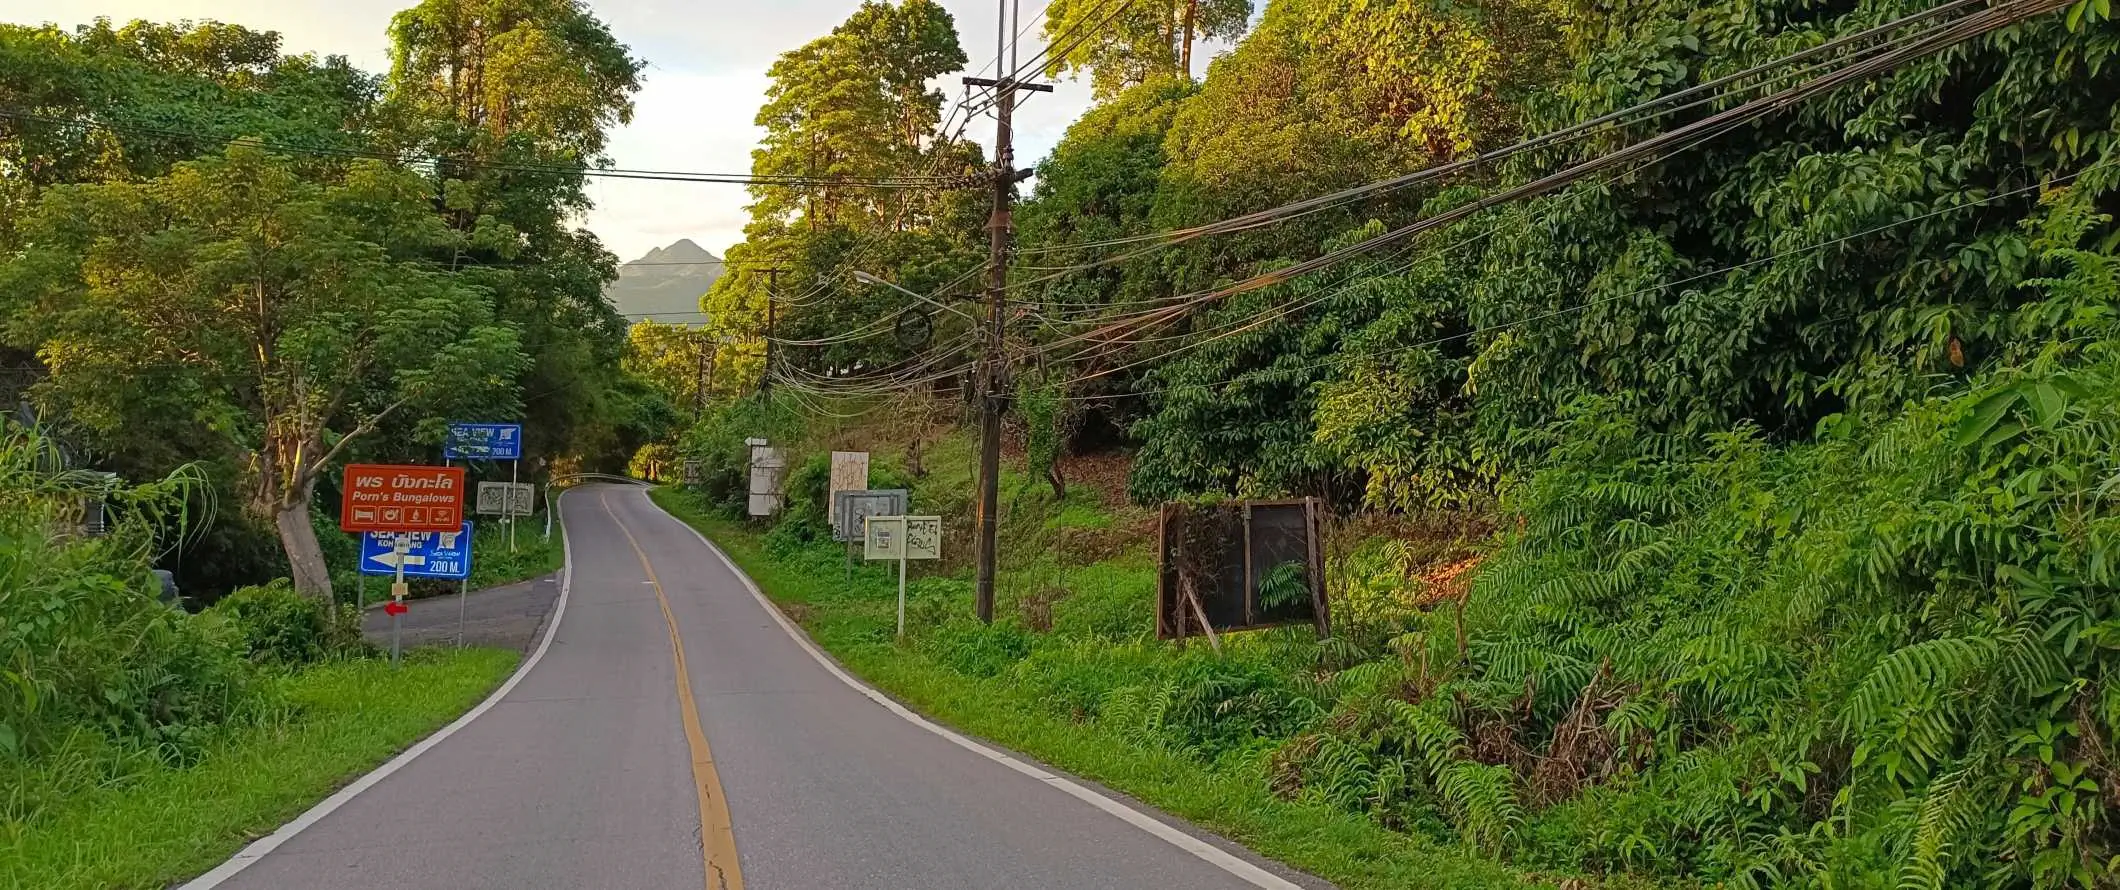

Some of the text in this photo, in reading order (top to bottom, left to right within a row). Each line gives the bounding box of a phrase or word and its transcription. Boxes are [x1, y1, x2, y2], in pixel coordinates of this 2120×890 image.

[451, 427, 495, 437] SEA VIEW
[355, 473, 453, 489] พร บังกะโล
[352, 491, 455, 504] Porn's Bungalows
[370, 530, 395, 539] SEA
[430, 560, 447, 573] 200
